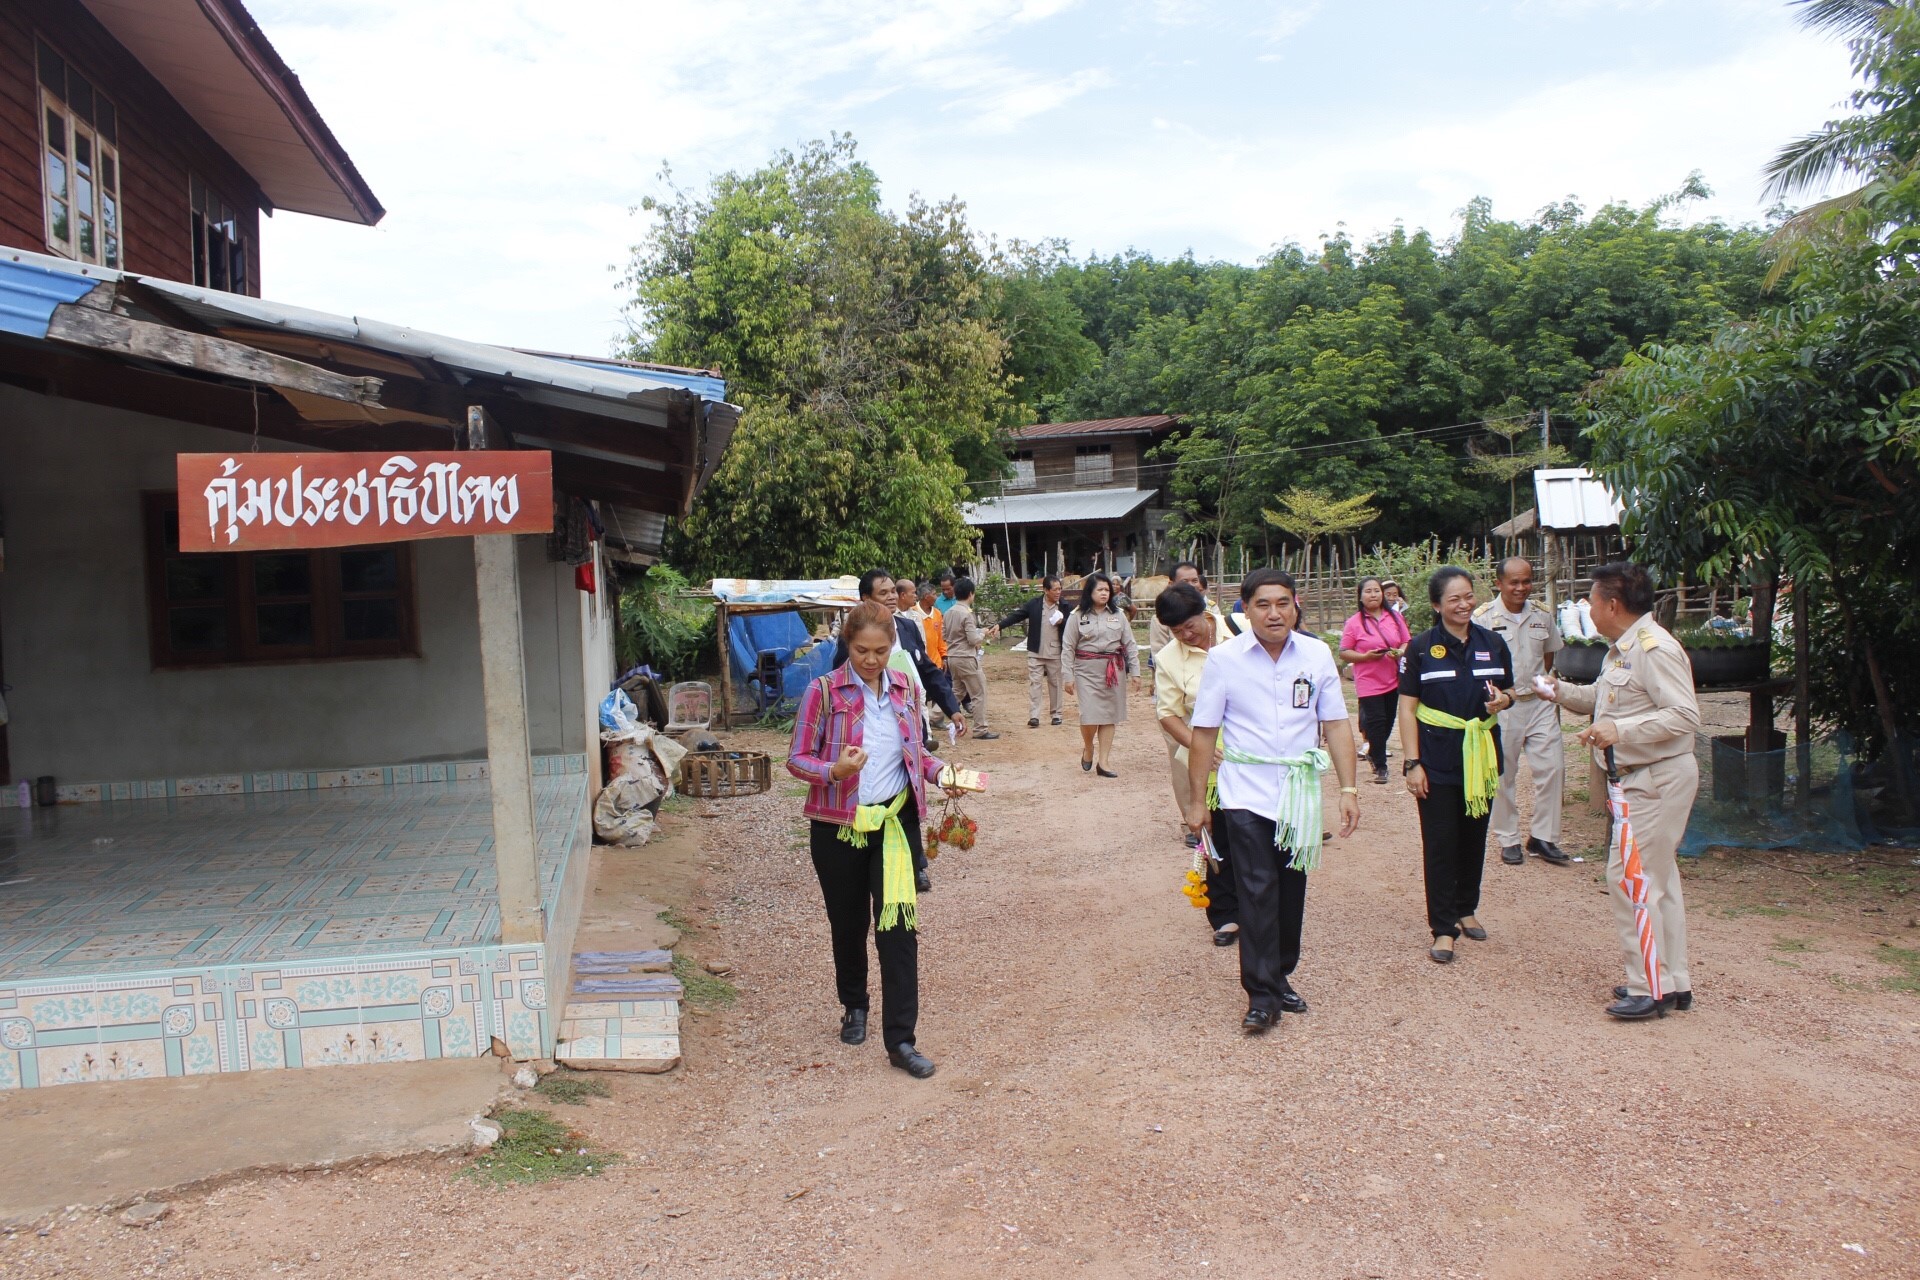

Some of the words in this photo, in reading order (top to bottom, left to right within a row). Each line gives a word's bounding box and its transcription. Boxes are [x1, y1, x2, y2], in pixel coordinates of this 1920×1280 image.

[204, 455, 520, 545] คุ้มประชาธิปไตย
